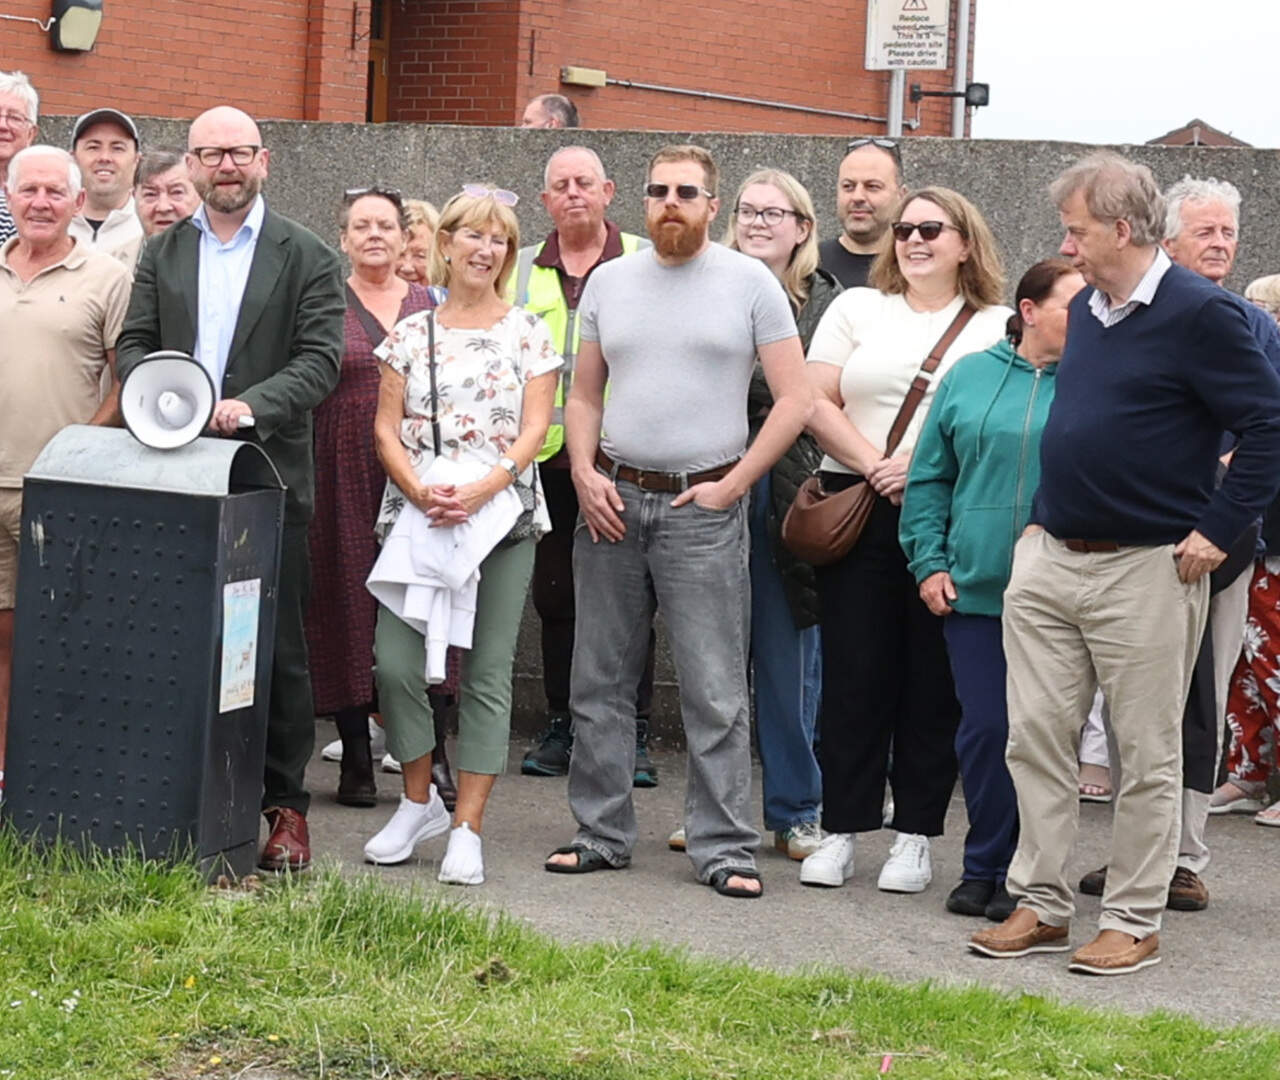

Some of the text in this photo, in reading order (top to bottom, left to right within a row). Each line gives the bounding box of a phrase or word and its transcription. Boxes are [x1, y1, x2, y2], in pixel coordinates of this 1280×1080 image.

[899, 14, 930, 22] Reduce
[892, 23, 917, 32] speed
[897, 31, 913, 39] This
[883, 40, 926, 49] pedestrian
[888, 49, 938, 57] Please drive
[907, 58, 937, 66] caution
